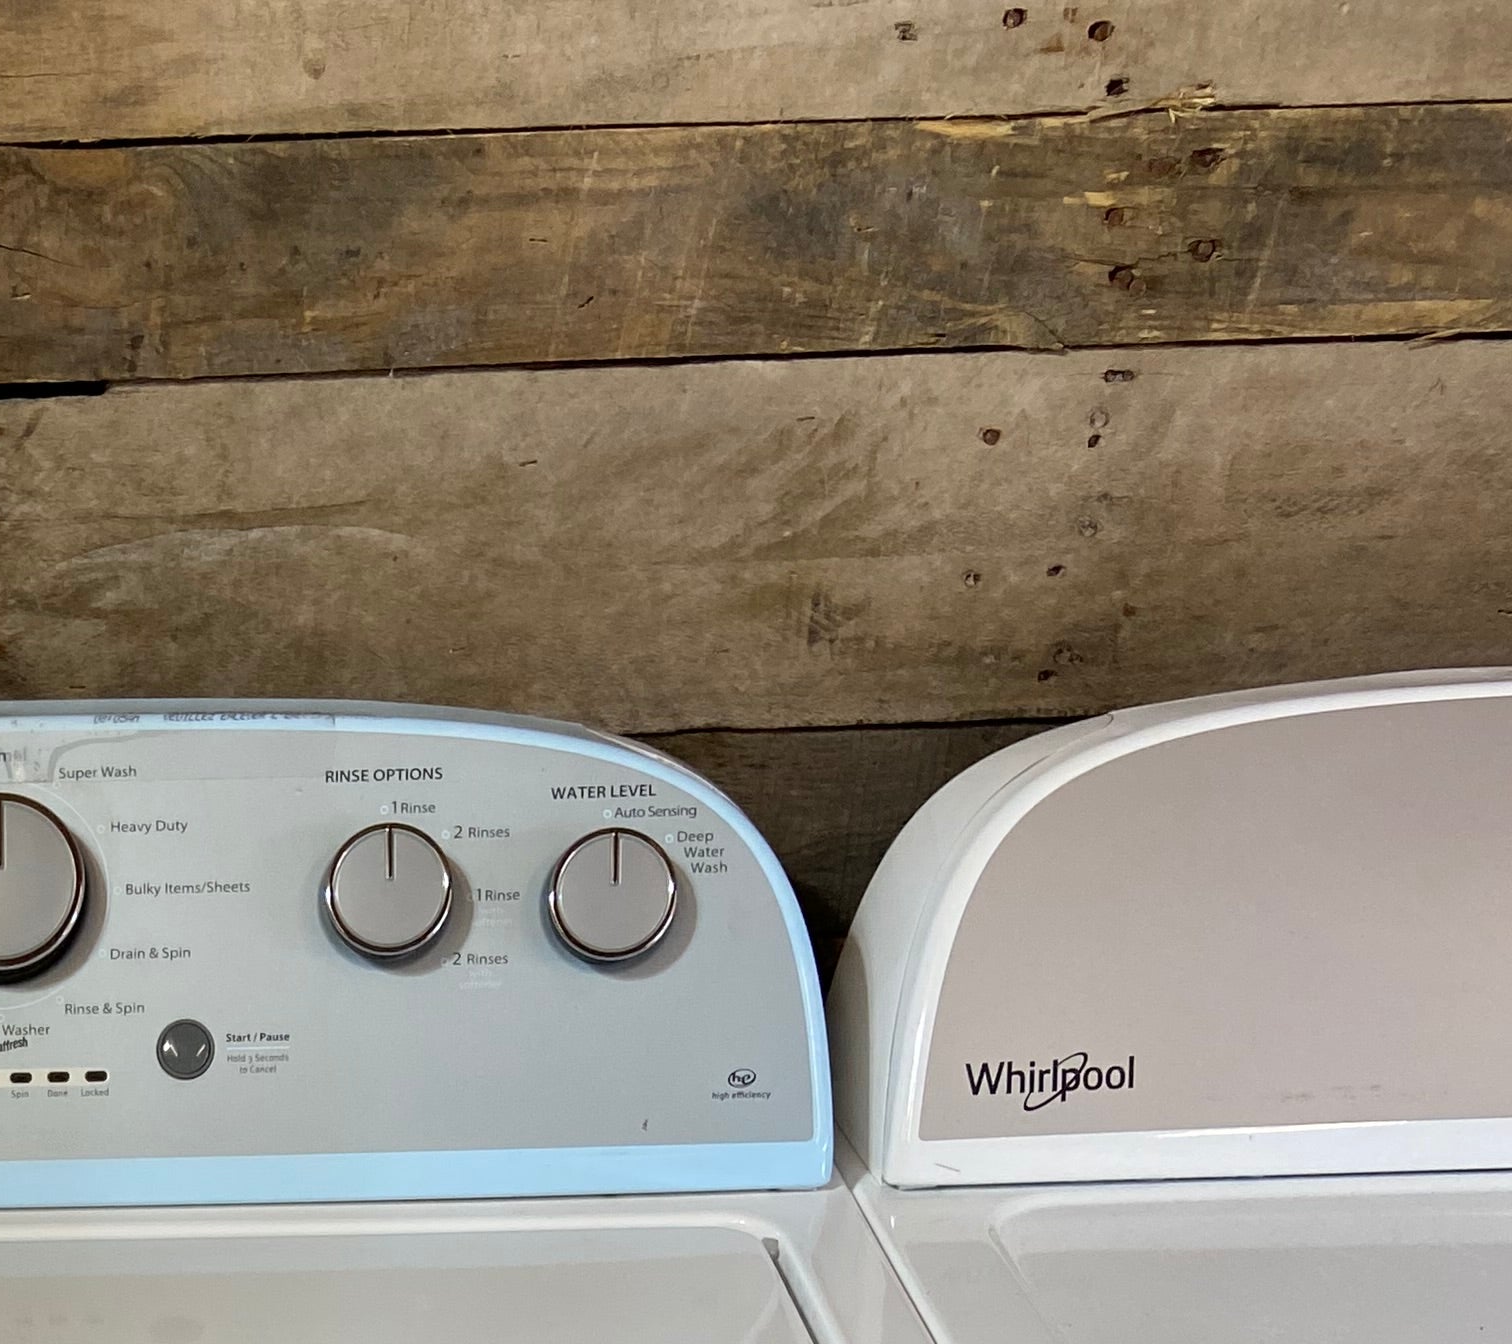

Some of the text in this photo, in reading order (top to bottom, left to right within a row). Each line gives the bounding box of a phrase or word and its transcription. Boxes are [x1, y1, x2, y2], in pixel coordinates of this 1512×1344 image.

[59, 765, 136, 781] Super Wash
[326, 768, 442, 783] RINSE OPTIONS
[552, 784, 656, 799] WATER LEVEL
[392, 801, 435, 813] 1 Rinse
[614, 806, 697, 818] Auto Sensing
[111, 820, 188, 834] Heavy Duty
[454, 825, 510, 839] 2 Rinses
[676, 830, 714, 845] Deep
[684, 845, 725, 859] Water
[691, 861, 727, 873] Wash
[126, 881, 250, 897] Bulky Items/Sheets
[477, 888, 520, 901] 1 Rinse
[111, 947, 190, 960] Drain & Spin
[452, 950, 508, 965] 2 Rinses
[65, 1002, 144, 1016] Rinse & Spin
[2, 1023, 50, 1037] Washer
[226, 1034, 251, 1042] Start
[260, 1033, 289, 1041] Pause
[249, 1063, 276, 1073] Cancel
[965, 1051, 1136, 1112] Whirlpool
[11, 1090, 29, 1099] Spin
[80, 1087, 110, 1097] Locked
[712, 1092, 771, 1101] high efficiency
